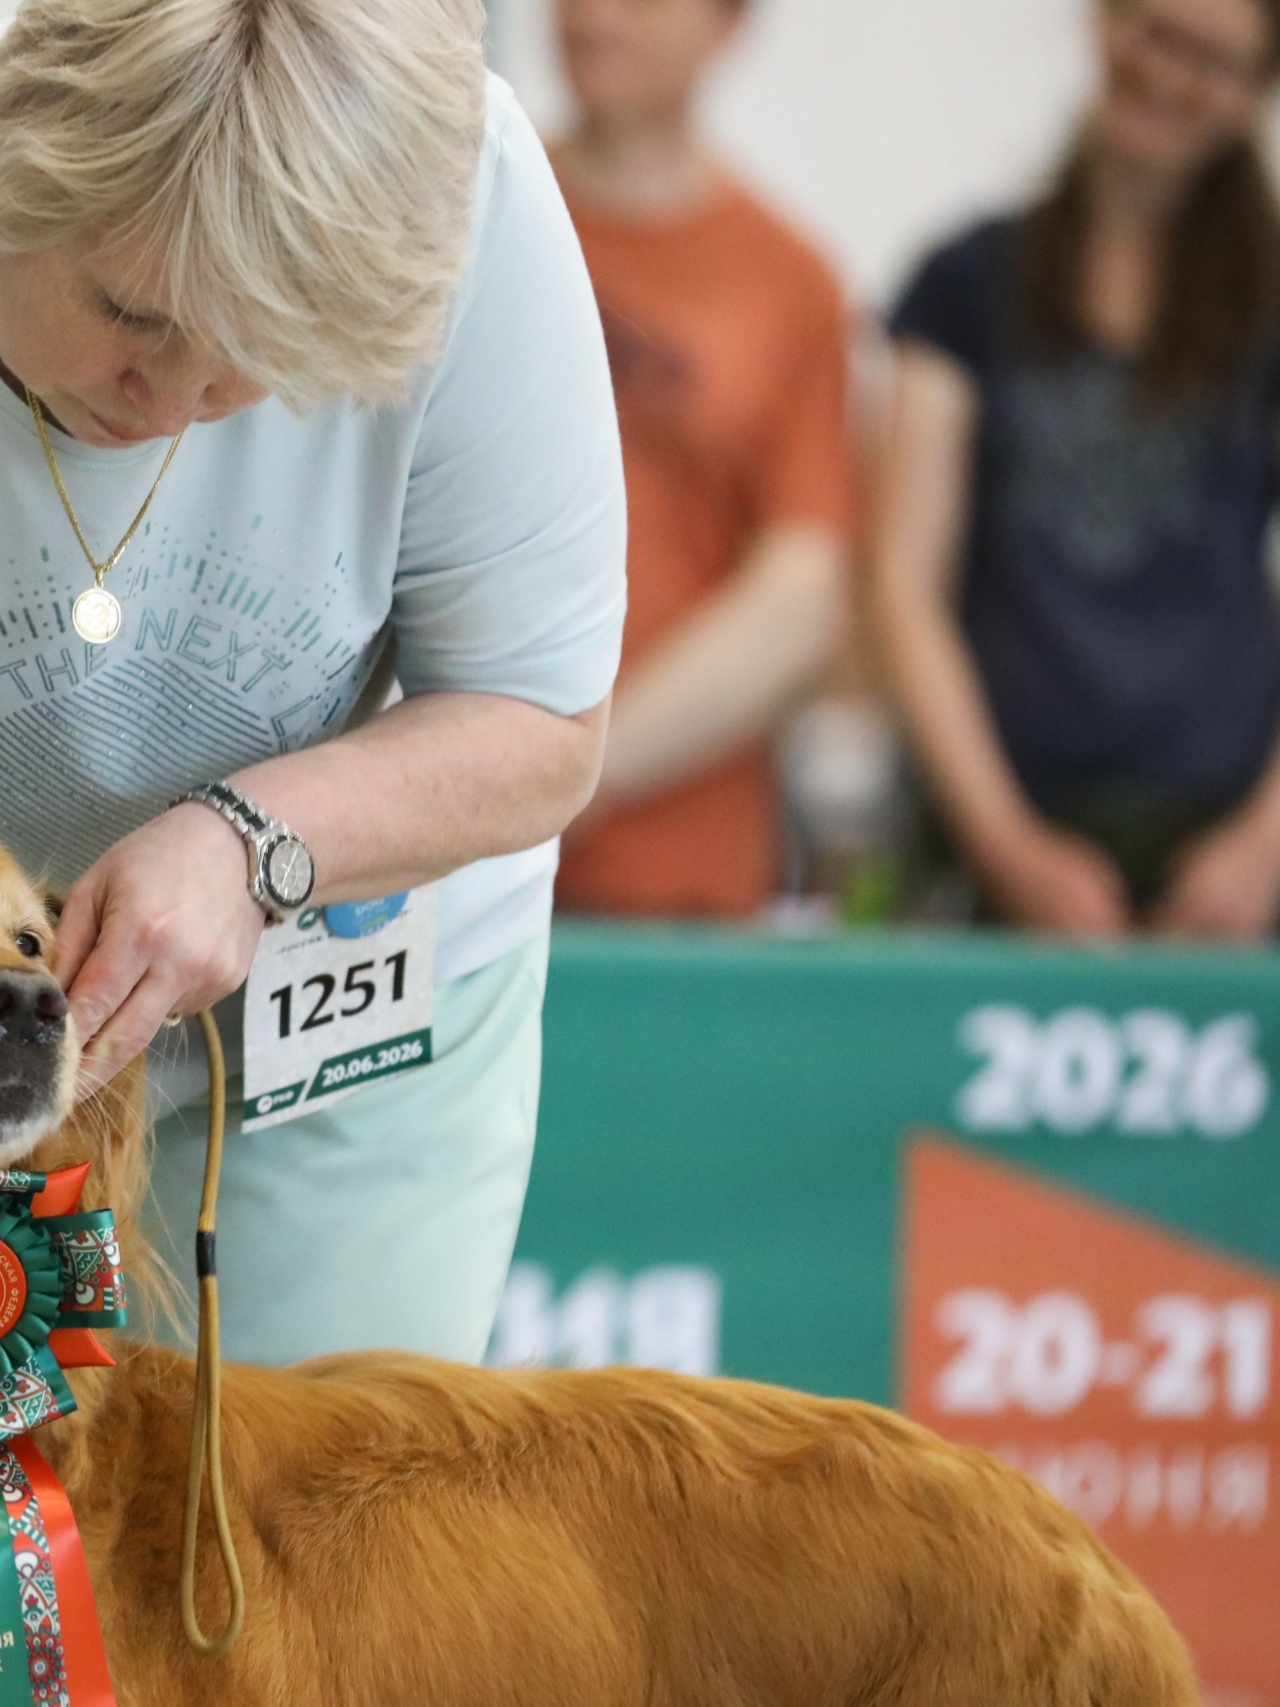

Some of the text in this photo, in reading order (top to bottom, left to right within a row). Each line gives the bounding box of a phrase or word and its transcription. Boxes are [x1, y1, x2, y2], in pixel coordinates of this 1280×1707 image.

[135, 607, 293, 693] NEXT
[270, 949, 408, 1039] 1251
[322, 1040, 423, 1088] 20.06.2026
[958, 1005, 1269, 1134] 2026
[938, 1288, 1273, 1418] 20-21
